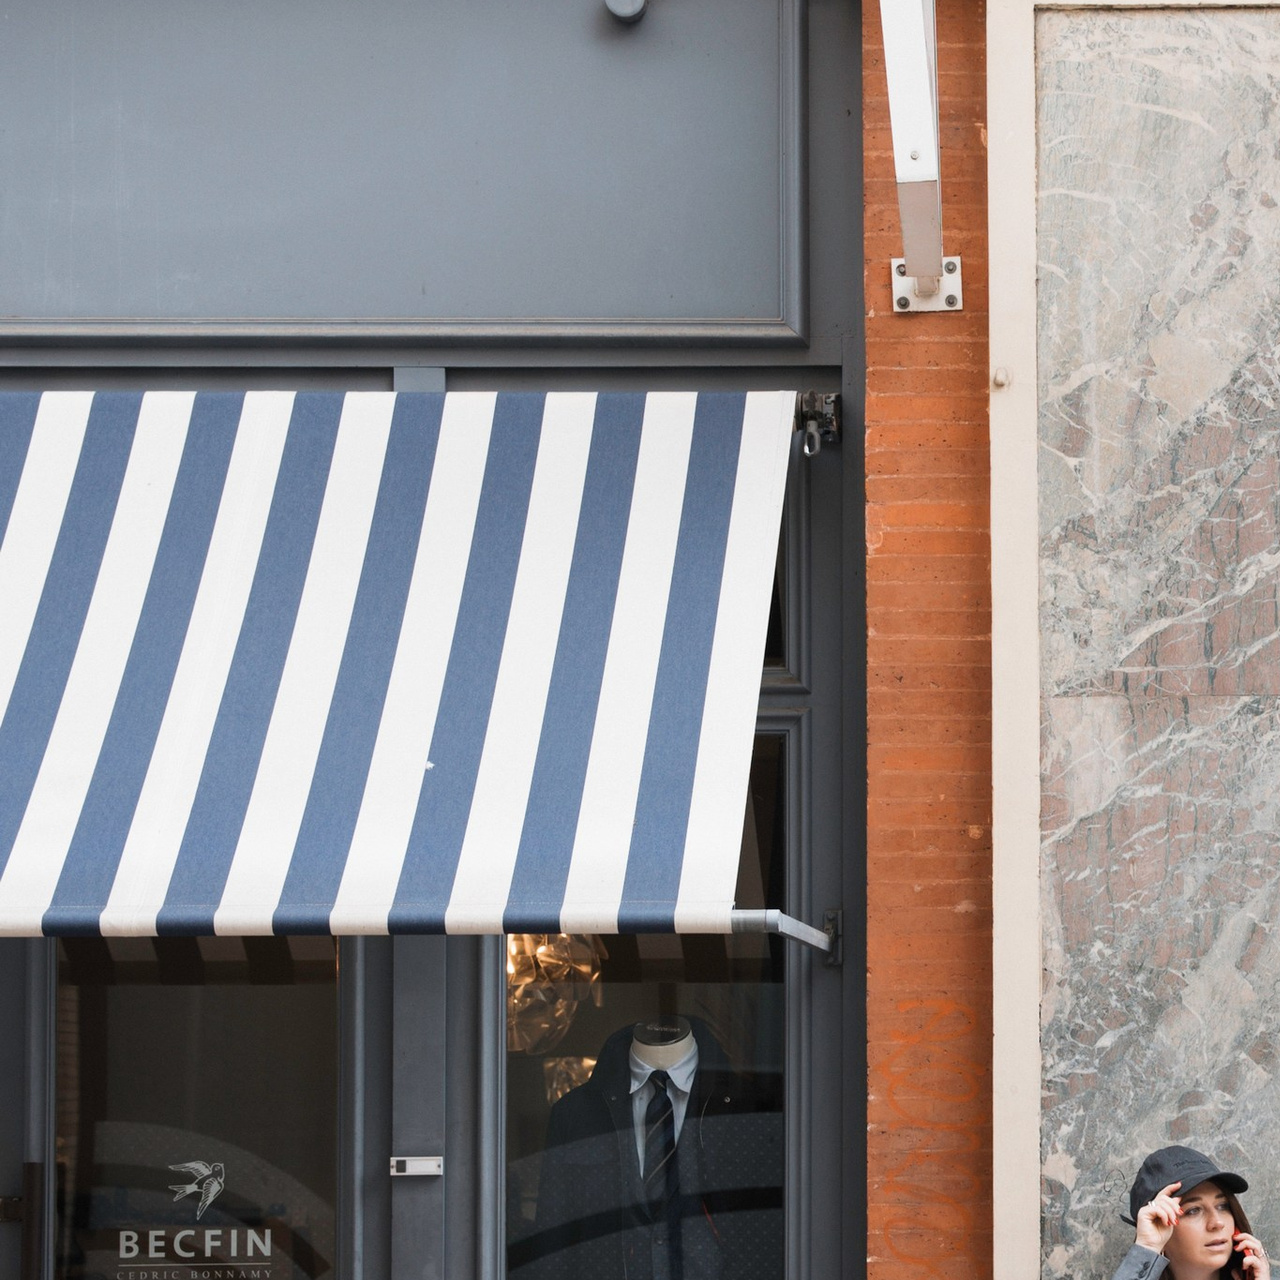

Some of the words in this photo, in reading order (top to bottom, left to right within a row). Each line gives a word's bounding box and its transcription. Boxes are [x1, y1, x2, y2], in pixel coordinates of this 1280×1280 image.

[119, 1229, 272, 1259] BECFIN
[116, 1271, 180, 1280] CEDRIC
[191, 1270, 272, 1280] BONNAMY
